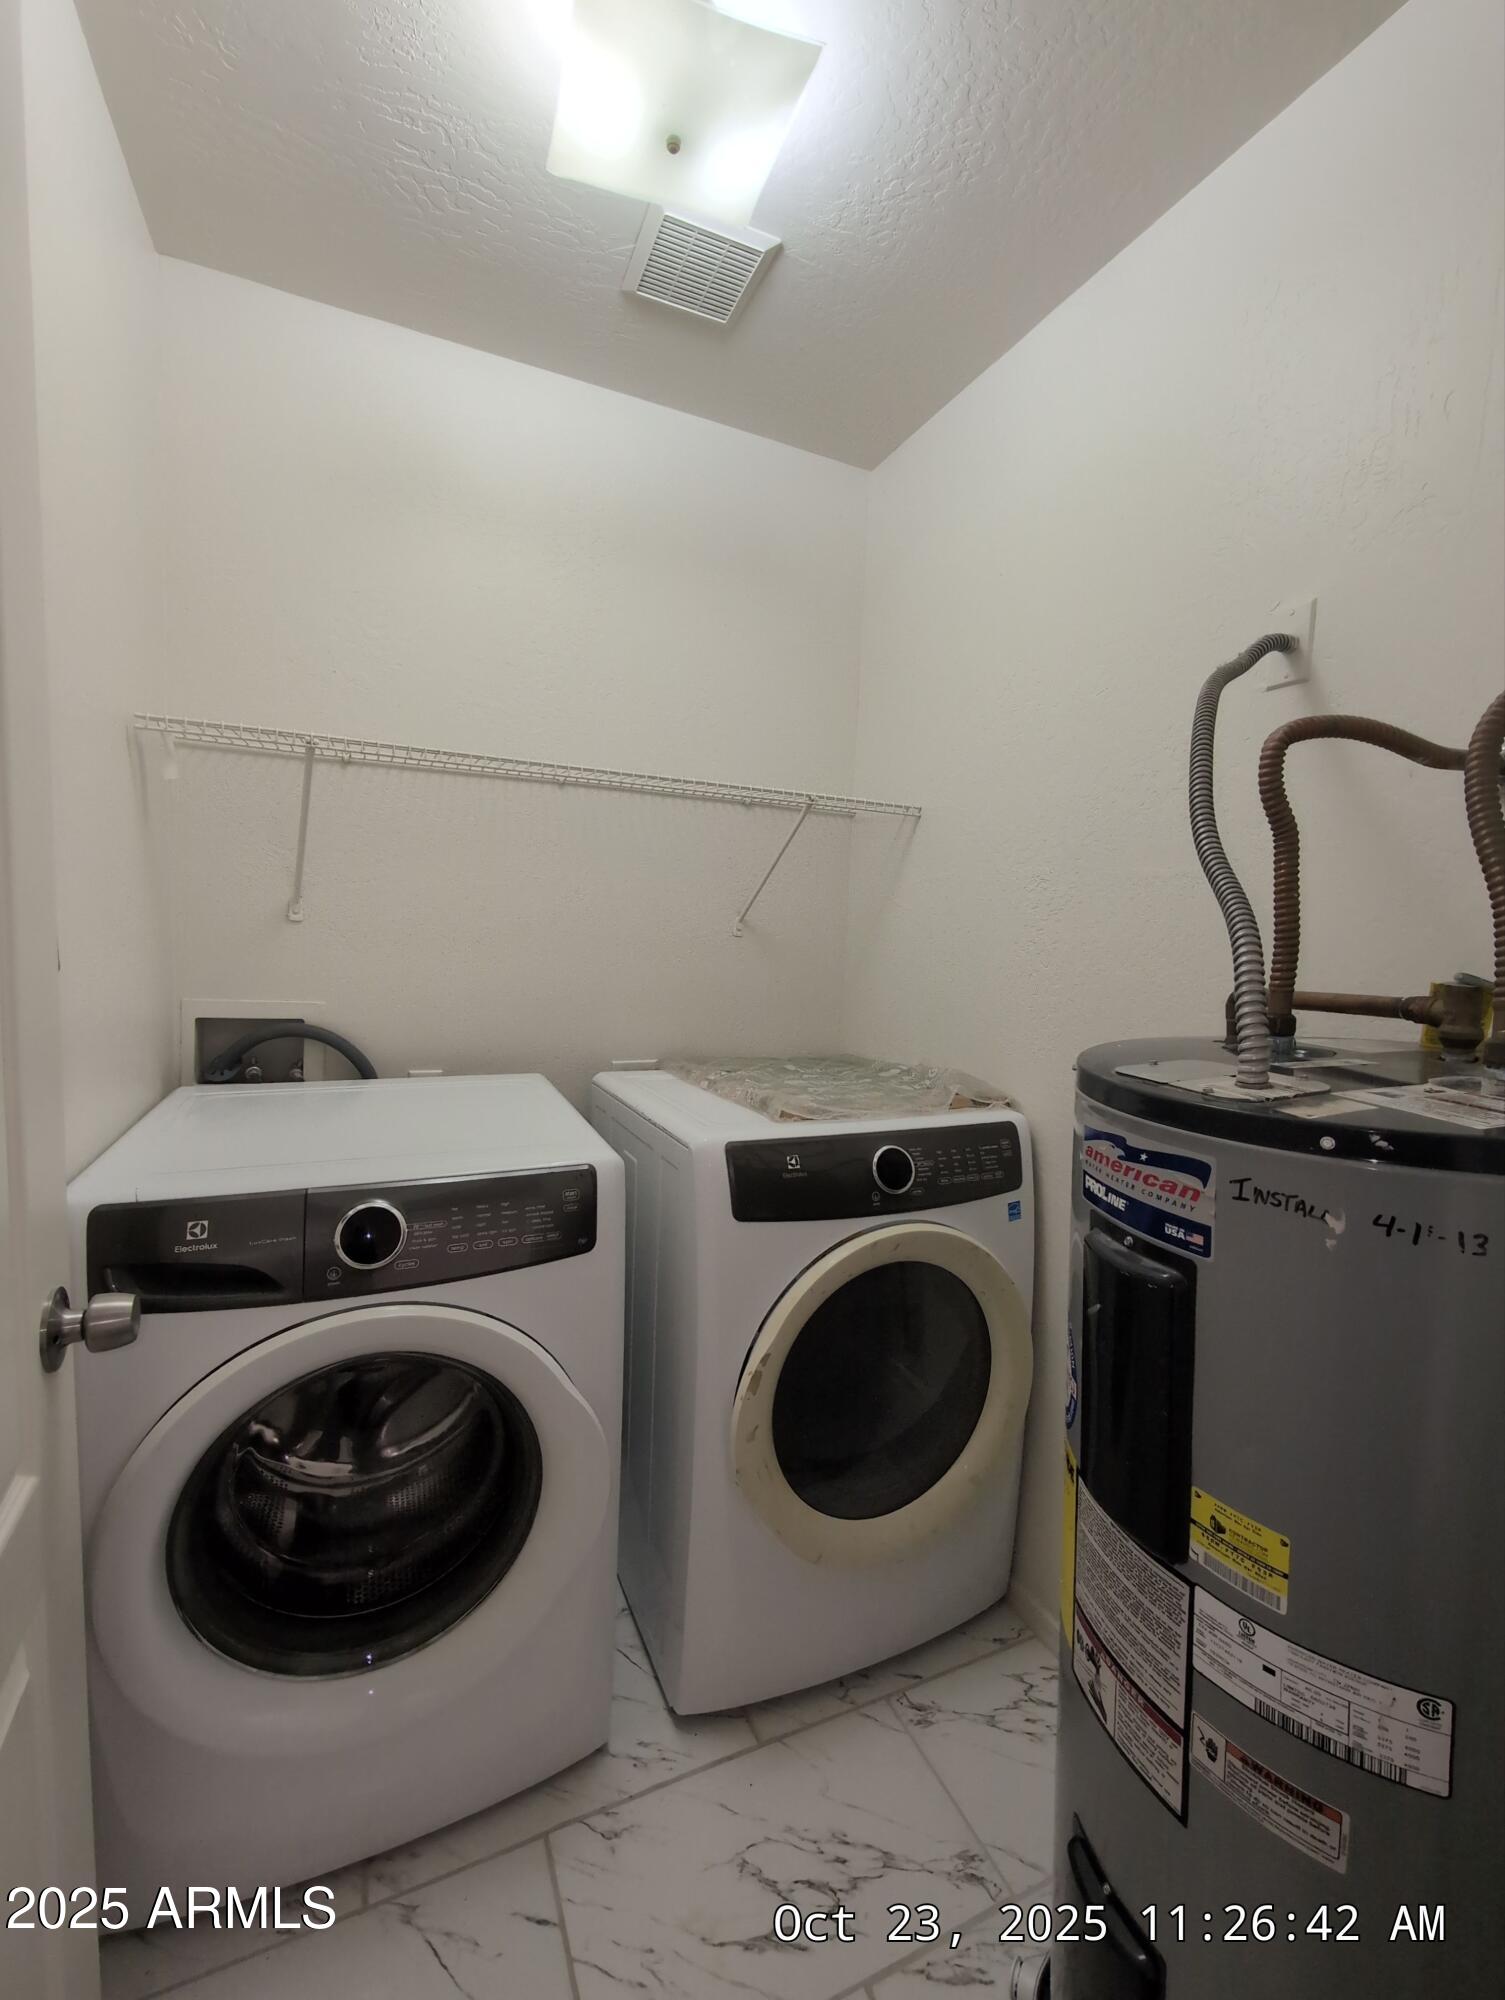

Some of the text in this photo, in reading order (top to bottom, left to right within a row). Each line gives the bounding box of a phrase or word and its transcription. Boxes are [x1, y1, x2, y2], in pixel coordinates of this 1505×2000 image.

[1085, 1145, 1201, 1202] american
[1085, 1174, 1127, 1212] PROLINE
[1140, 1188, 1197, 1213] COMPANY
[1164, 1225, 1186, 1241] USA
[174, 1243, 218, 1254] Electrolux
